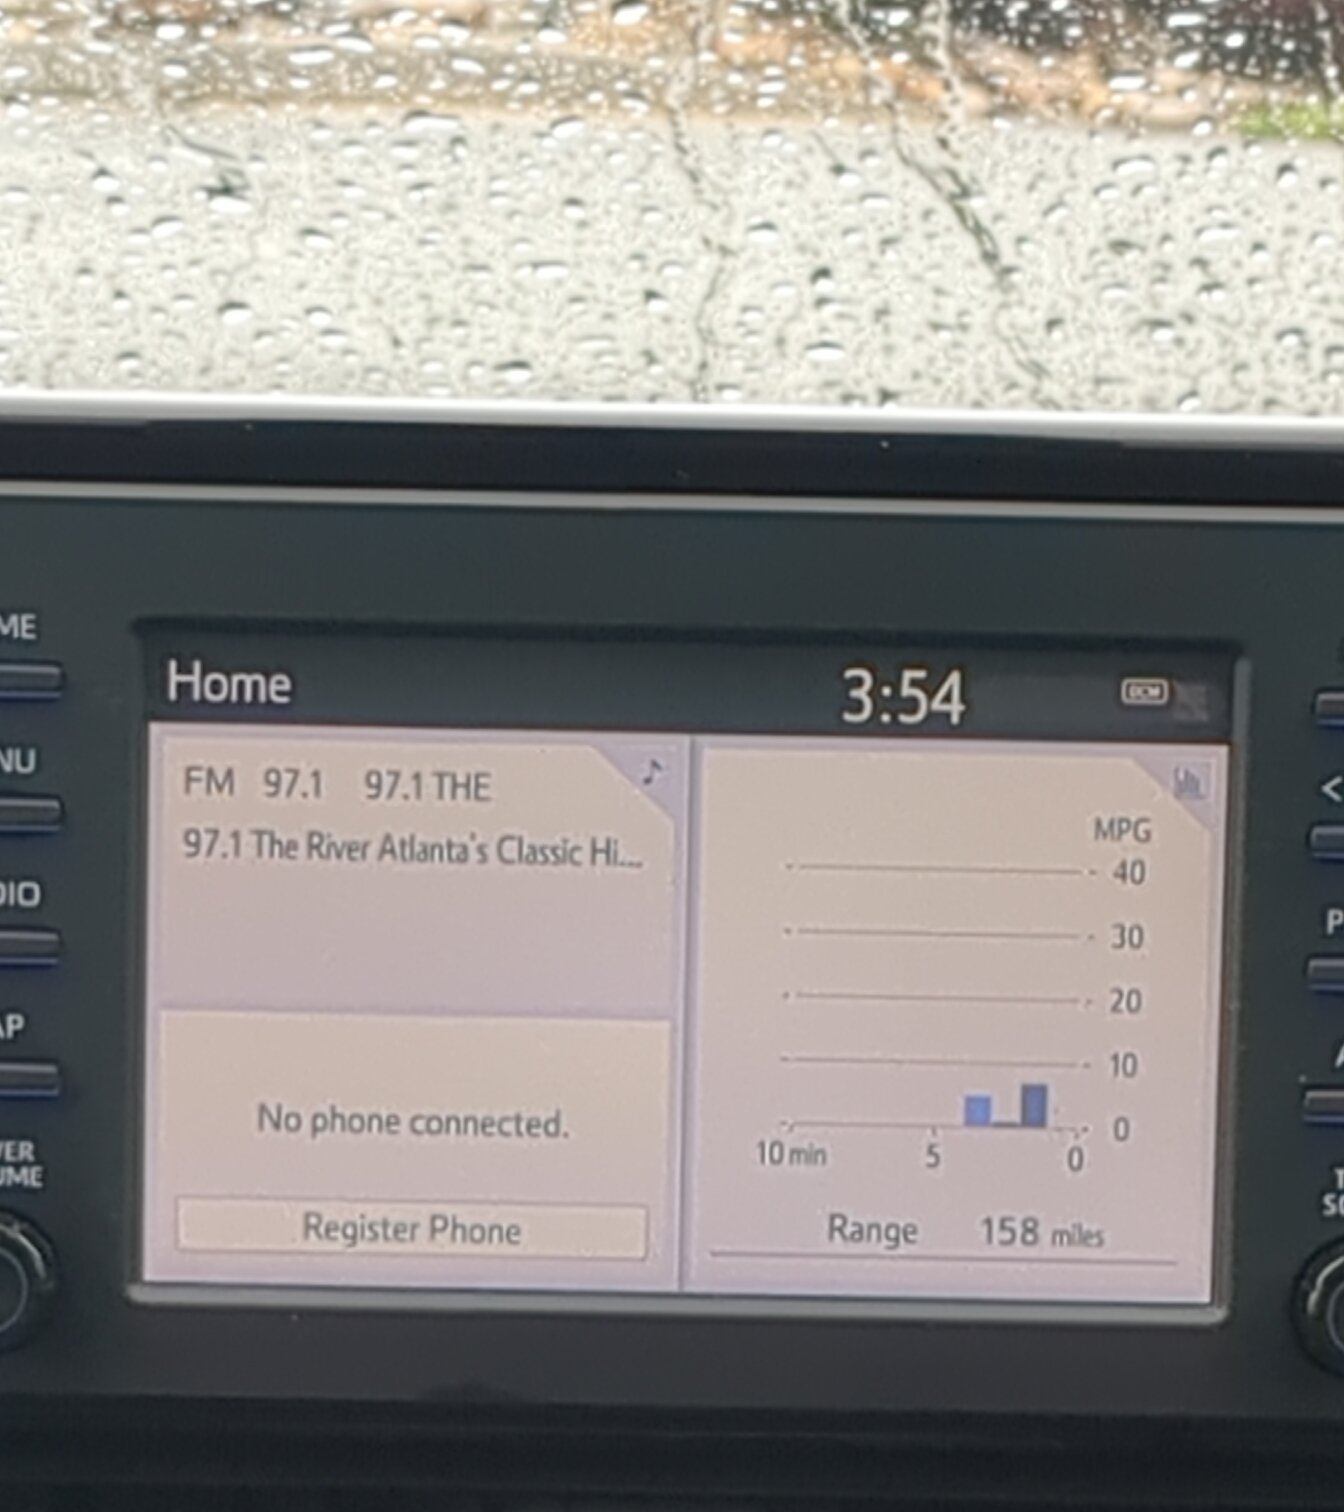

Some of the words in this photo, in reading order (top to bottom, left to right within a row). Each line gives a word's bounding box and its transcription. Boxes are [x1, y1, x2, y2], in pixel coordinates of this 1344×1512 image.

[167, 660, 292, 704] Home
[842, 668, 966, 725] 3:54
[183, 767, 235, 798] FM
[264, 768, 323, 799] 97.1
[365, 770, 424, 801] 97.1
[432, 772, 491, 802] THE
[1094, 817, 1153, 844] MPG
[183, 830, 242, 859] 97.1
[254, 832, 298, 861] The
[307, 832, 369, 863] River
[378, 832, 489, 864] Atlanta's
[496, 836, 583, 866] Classic
[1113, 859, 1147, 884] 40
[1110, 924, 1145, 949] 30
[1109, 989, 1143, 1013] 20
[1110, 1053, 1138, 1078] 10
[257, 1104, 302, 1134] No
[311, 1106, 401, 1140] phone
[409, 1107, 569, 1139] connected.
[1113, 1117, 1130, 1142] 0
[757, 1141, 783, 1166] 10
[789, 1143, 827, 1166] min
[926, 1144, 941, 1169] 5
[1067, 1147, 1085, 1172] 0
[303, 1213, 420, 1247] Register
[429, 1214, 521, 1245] Phone
[828, 1214, 919, 1249] Range
[982, 1218, 1039, 1246] 158
[1051, 1224, 1104, 1248] miles
